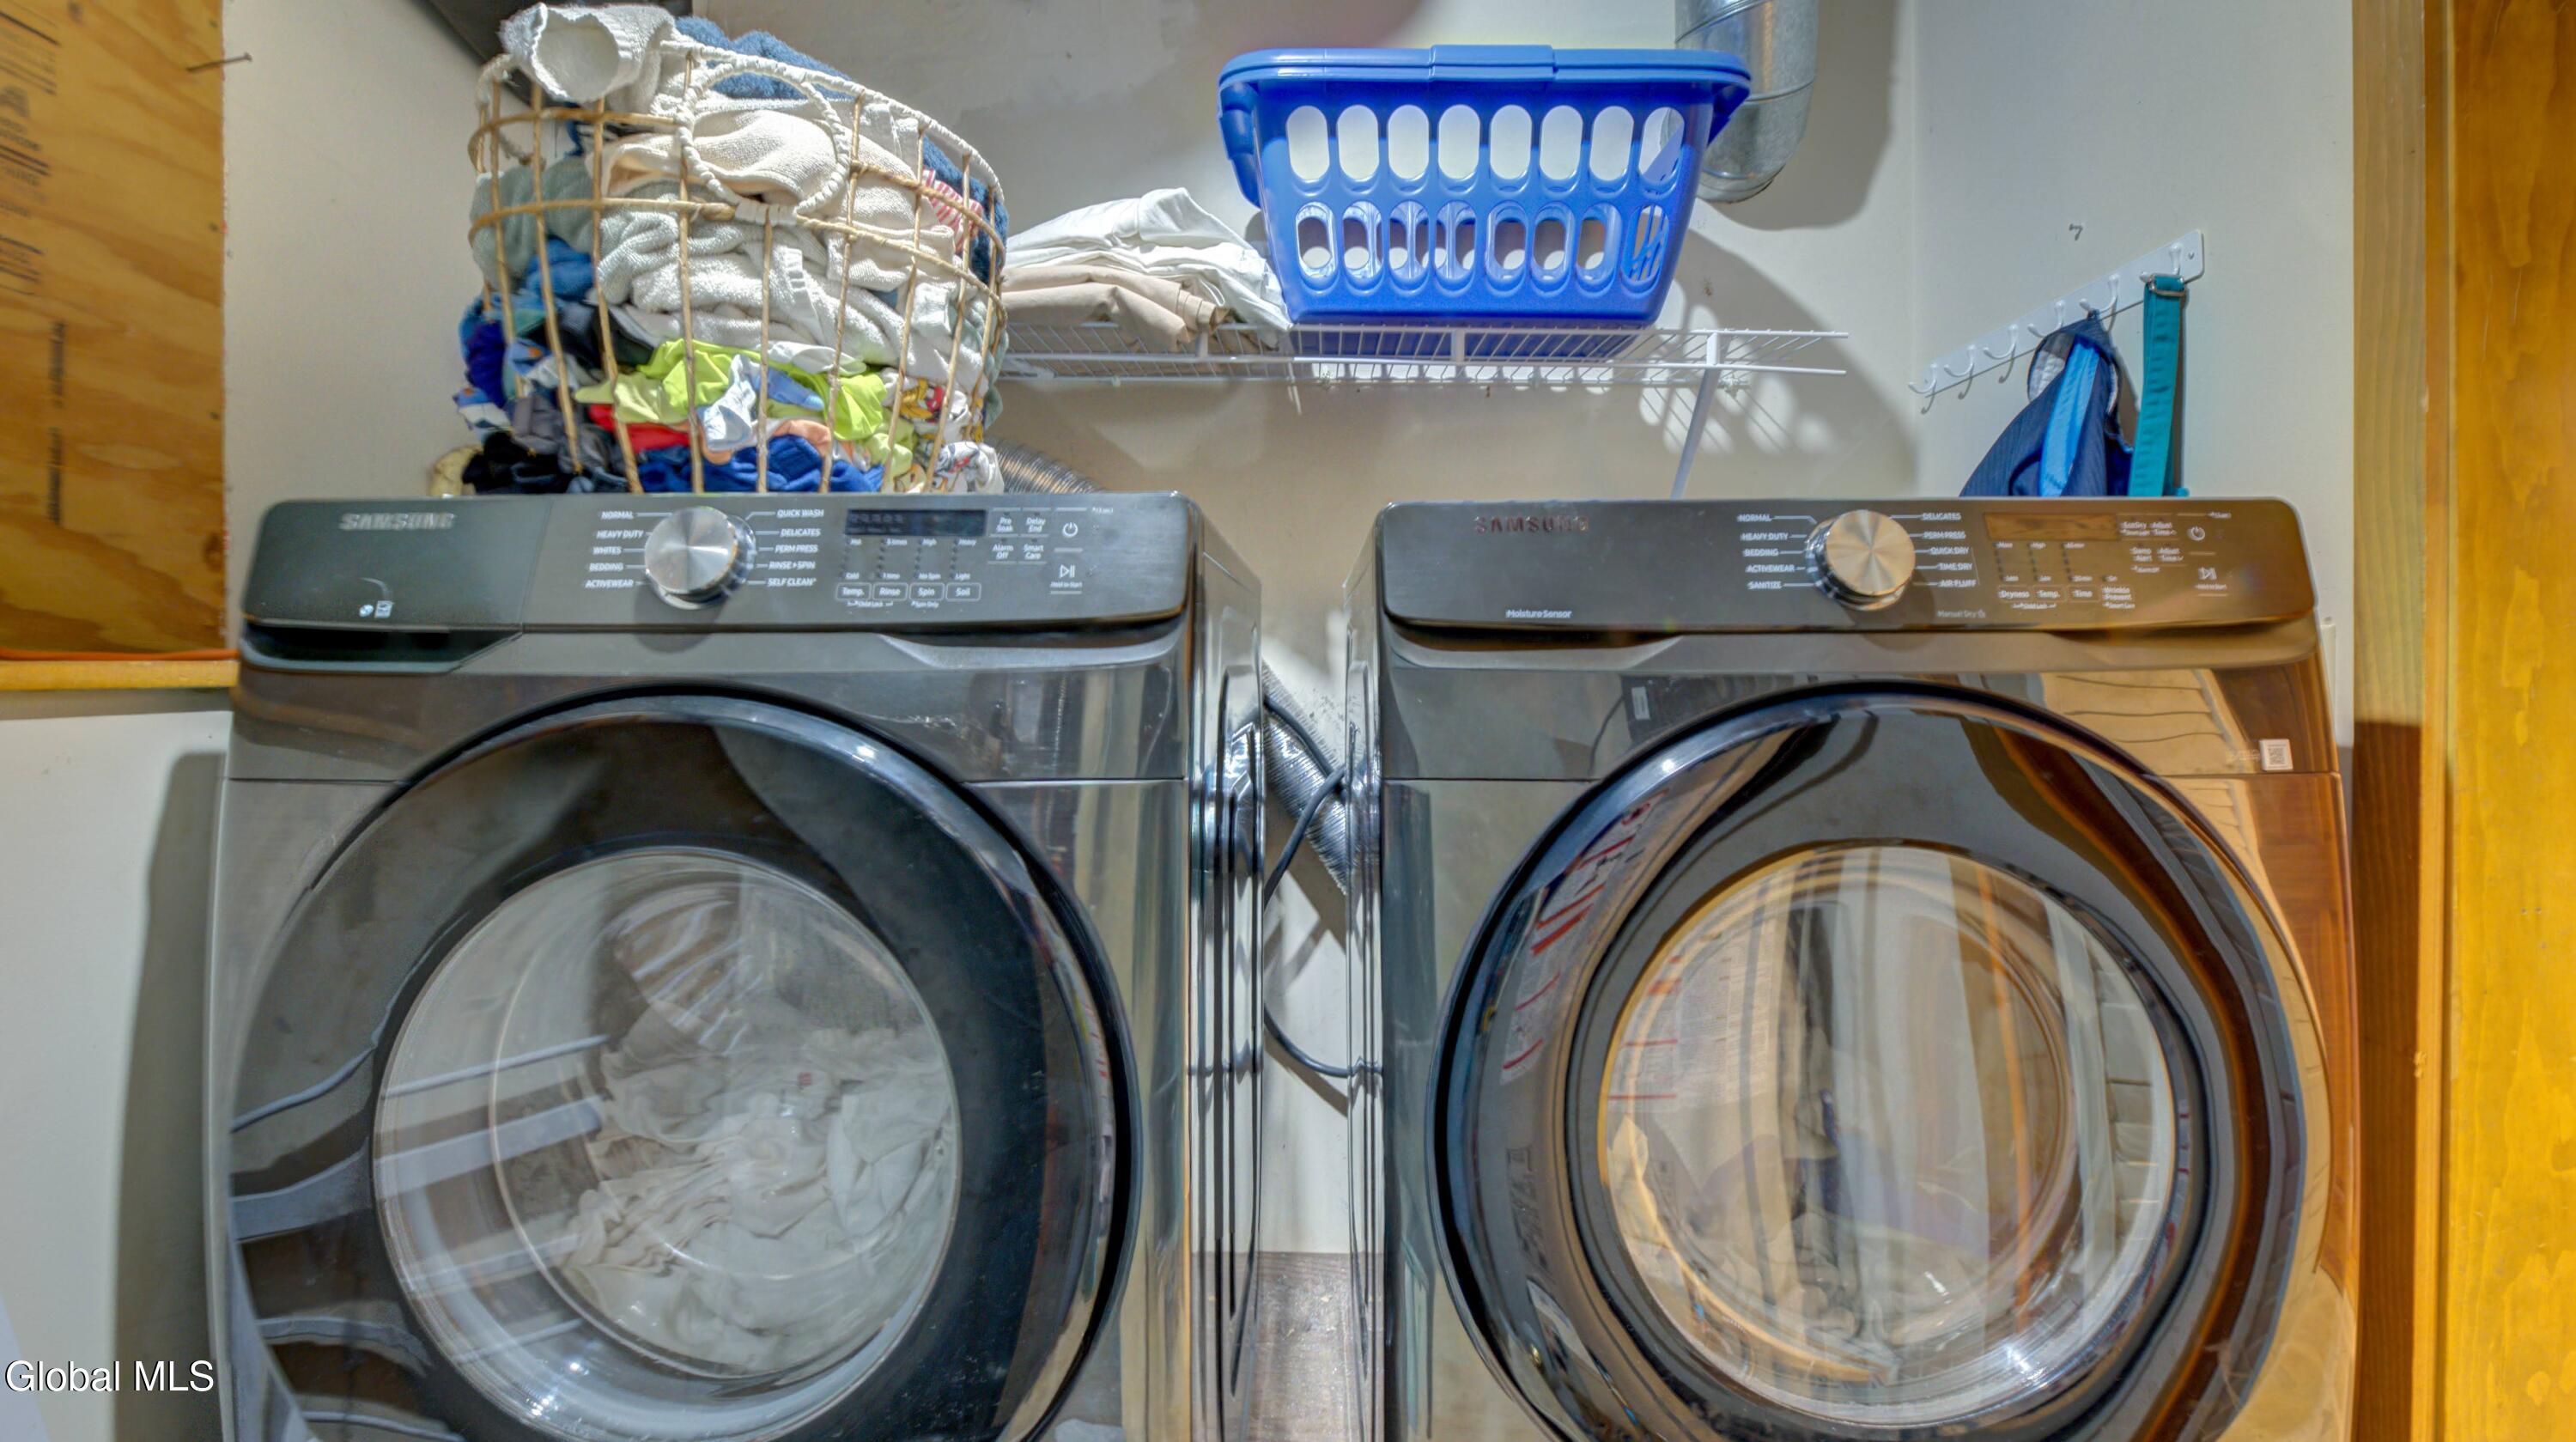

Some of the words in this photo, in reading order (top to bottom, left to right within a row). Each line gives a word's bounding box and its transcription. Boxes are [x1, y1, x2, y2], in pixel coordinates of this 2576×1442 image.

[601, 511, 634, 520] NORMAL
[777, 508, 800, 519] QUICK
[801, 508, 824, 518] WASH
[1737, 514, 1772, 522] NORMAL
[338, 512, 455, 531] SAMSUNG
[1026, 517, 1046, 526] Delay
[1474, 515, 1589, 533] SAMSUNG
[780, 528, 821, 538] DELICATES
[1029, 525, 1043, 533] End
[596, 529, 623, 539] HEAVY
[623, 529, 644, 539] DUTY
[1740, 532, 1768, 541] HEAVY
[1768, 532, 1789, 541] DUTY
[592, 546, 622, 555] WHITES
[775, 544, 795, 554] PERM
[796, 544, 818, 554] PRESS
[992, 544, 1014, 552] Alarm
[1024, 544, 1044, 552] Smart
[1742, 548, 1779, 557] BEDDING
[589, 563, 624, 572] BEDDING
[1745, 564, 1795, 573] ACTIVEWEAR
[585, 579, 634, 588] ACTIVEWEAR
[768, 577, 787, 587] SELF
[1747, 581, 1783, 590] SANITIZE
[842, 587, 865, 597] Temp.
[879, 587, 901, 597] Rinse
[917, 587, 935, 598] Spin
[955, 587, 971, 597] Soil
[1998, 590, 2030, 599] Dryness
